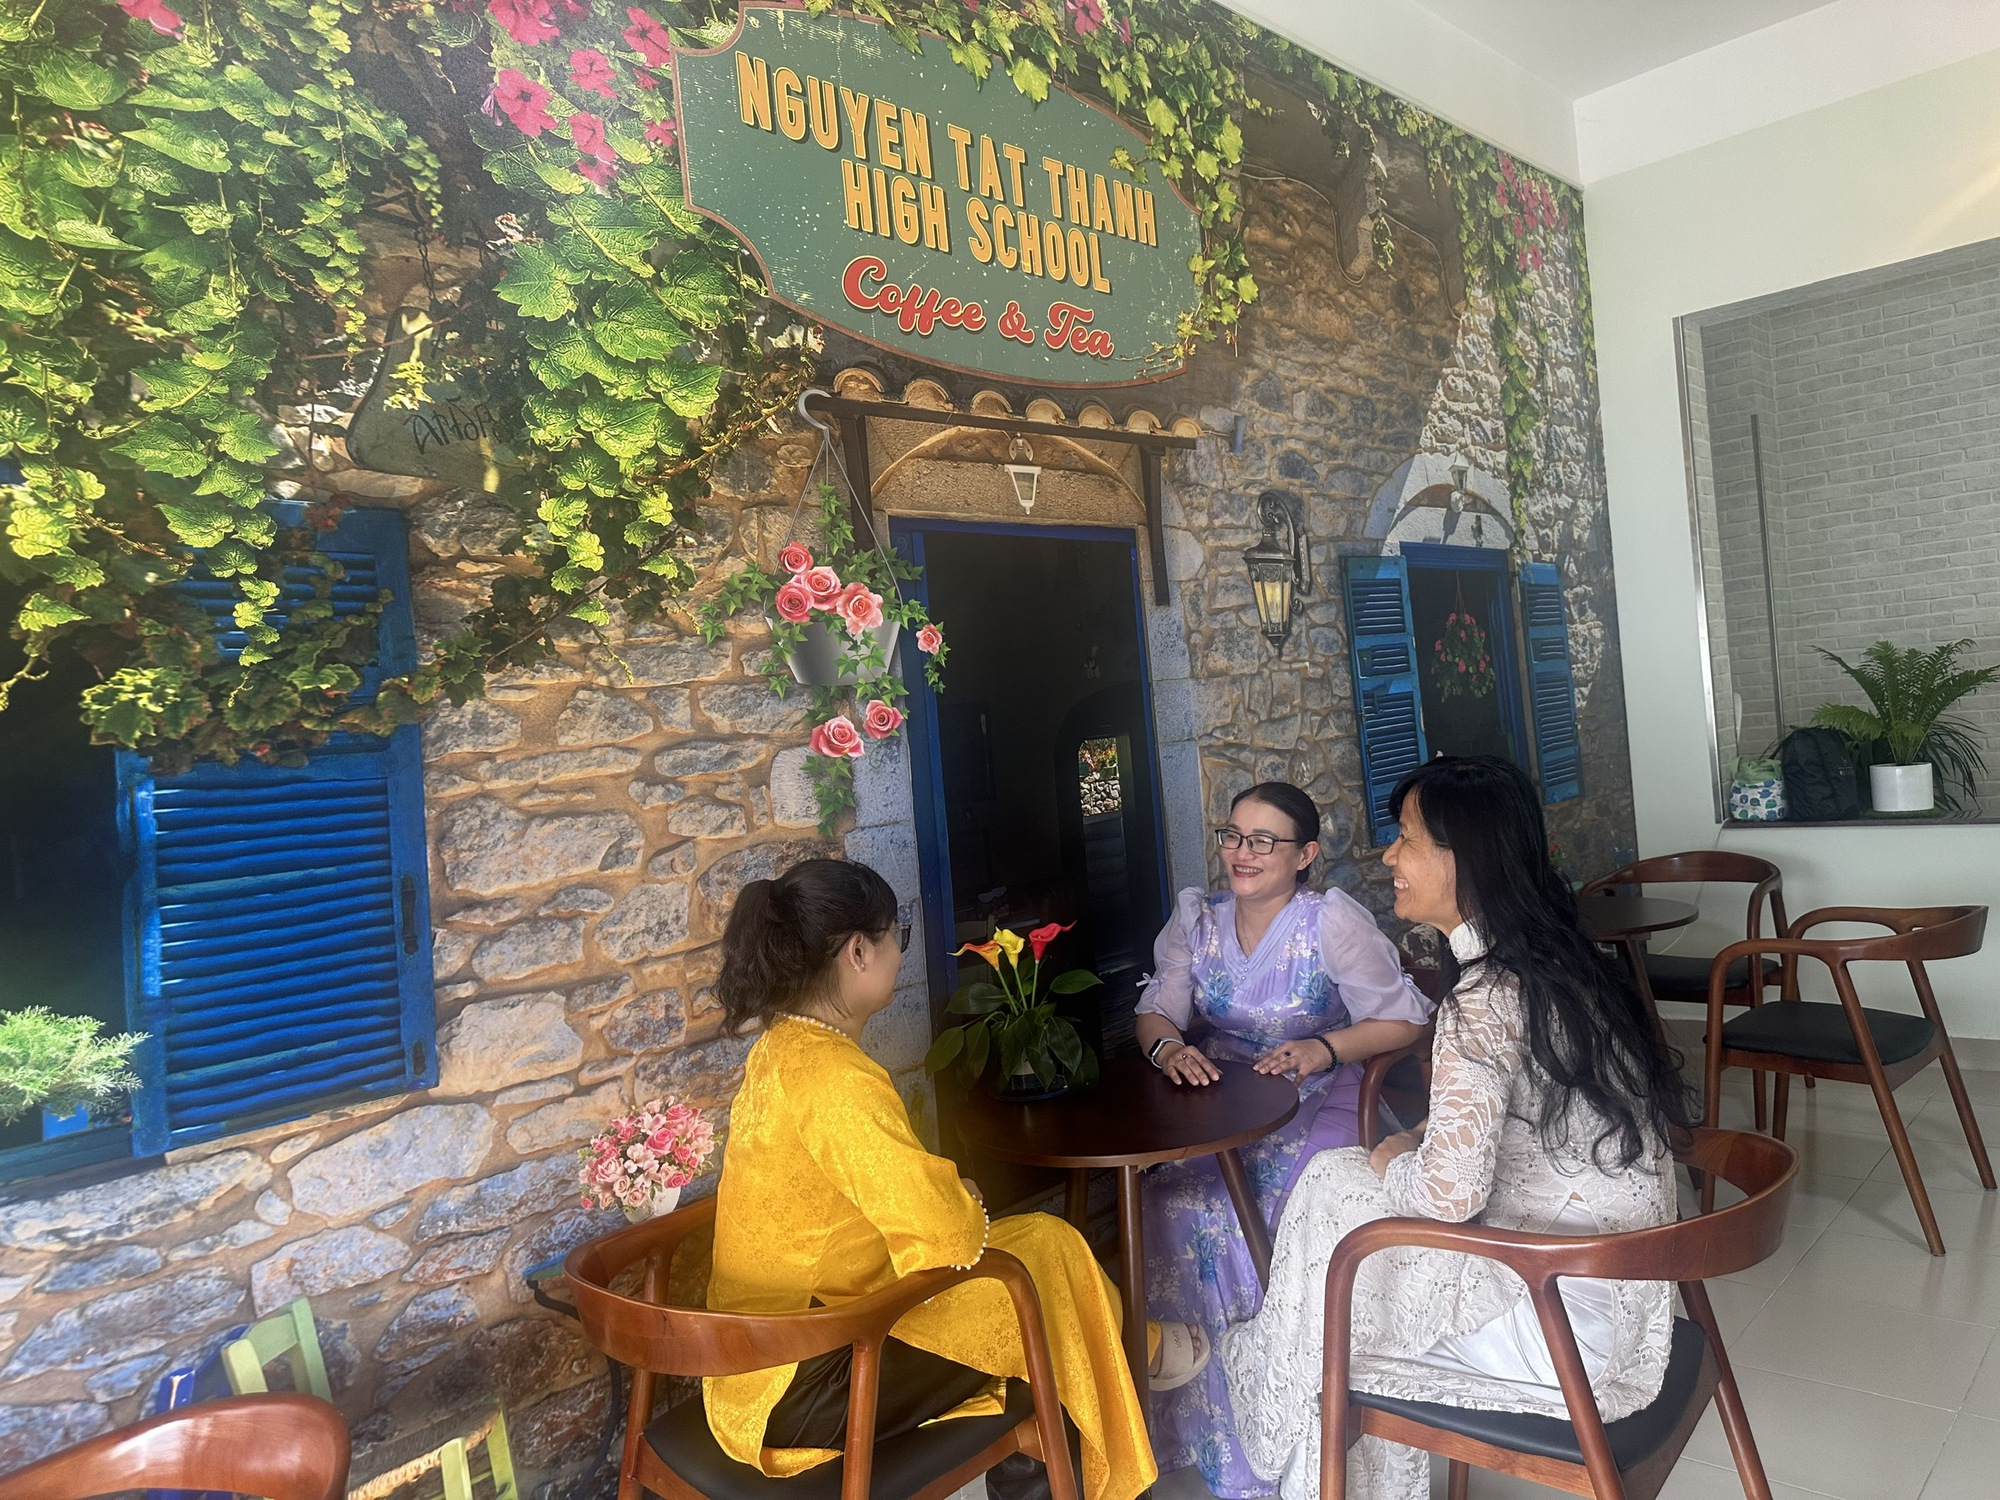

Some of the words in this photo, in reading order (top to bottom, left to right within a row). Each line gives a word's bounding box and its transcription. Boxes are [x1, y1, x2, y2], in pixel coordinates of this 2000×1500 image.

[736, 51, 932, 179] NGUYEN
[948, 123, 1026, 207] TAT
[1043, 156, 1157, 246] THANH
[841, 159, 949, 252] HIGH
[966, 197, 1111, 293] SCHOOL
[842, 256, 987, 336] Coffee
[999, 301, 1034, 343] &
[1044, 302, 1114, 358] Tea
